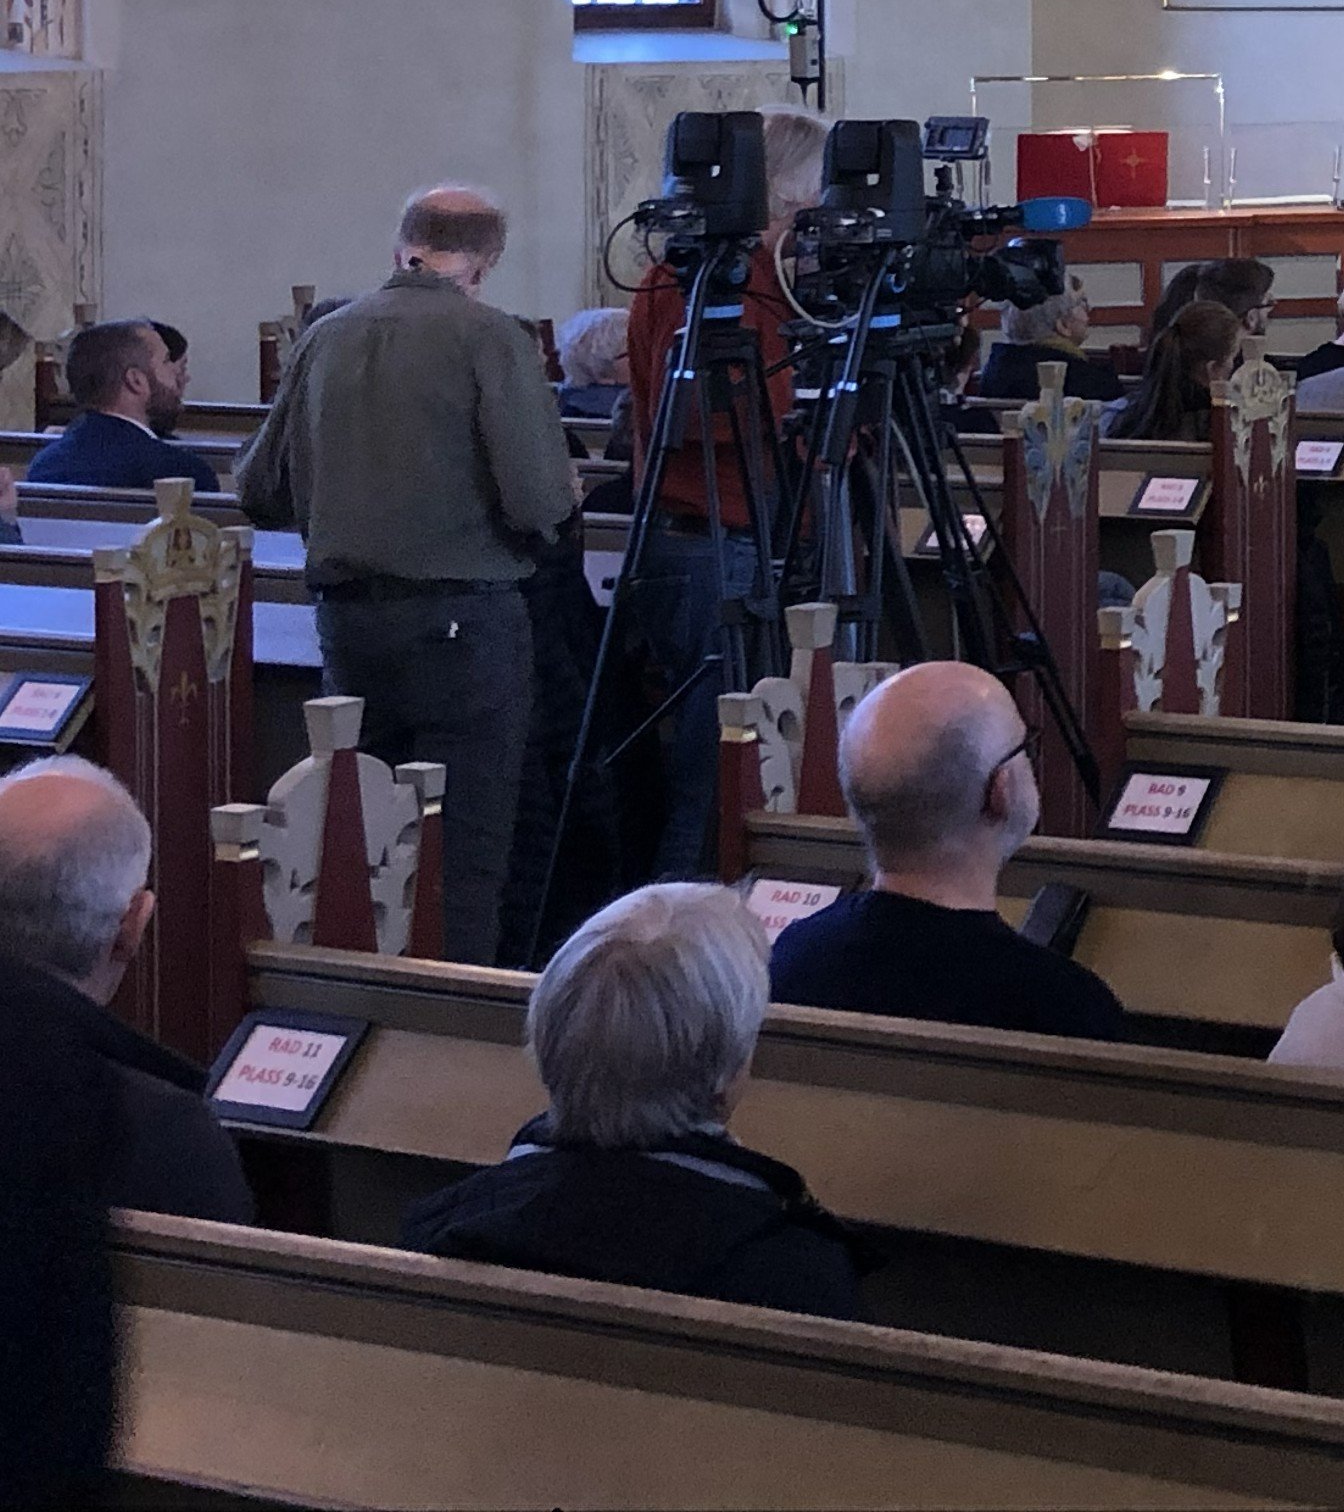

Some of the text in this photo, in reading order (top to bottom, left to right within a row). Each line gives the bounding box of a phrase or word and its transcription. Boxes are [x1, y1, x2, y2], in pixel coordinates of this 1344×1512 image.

[1147, 782, 1175, 795] RAD
[1123, 803, 1161, 817] PLASS
[771, 890, 821, 906] RAD 10
[268, 1036, 322, 1058] RAD 11
[239, 1064, 320, 1090] PLASS 9-16
